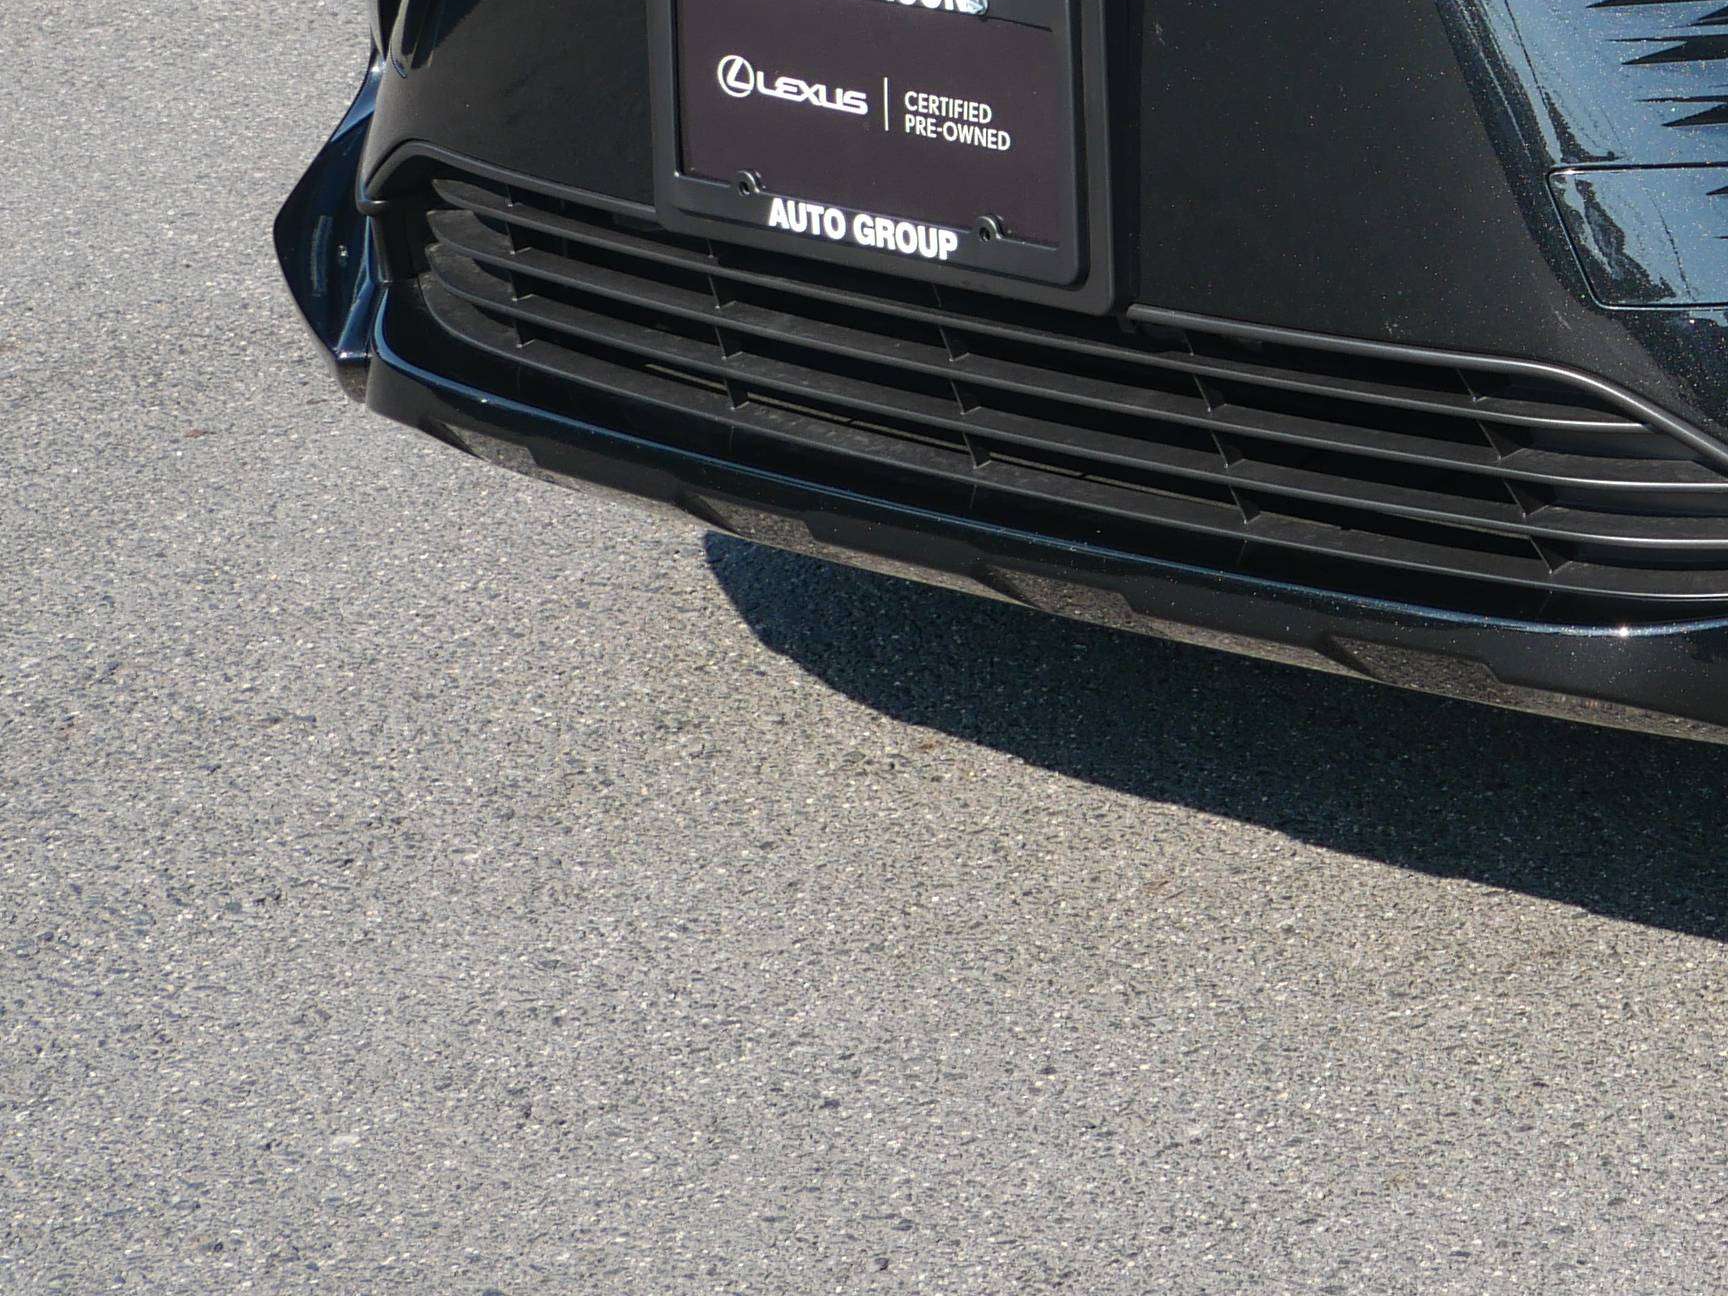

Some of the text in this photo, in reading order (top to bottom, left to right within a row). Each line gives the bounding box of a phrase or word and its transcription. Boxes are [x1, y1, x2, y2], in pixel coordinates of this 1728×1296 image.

[757, 70, 993, 125] LEXUS CERTIFIED
[905, 113, 1011, 152] PRE-OWNED
[768, 197, 959, 261] AUTO GROUP
